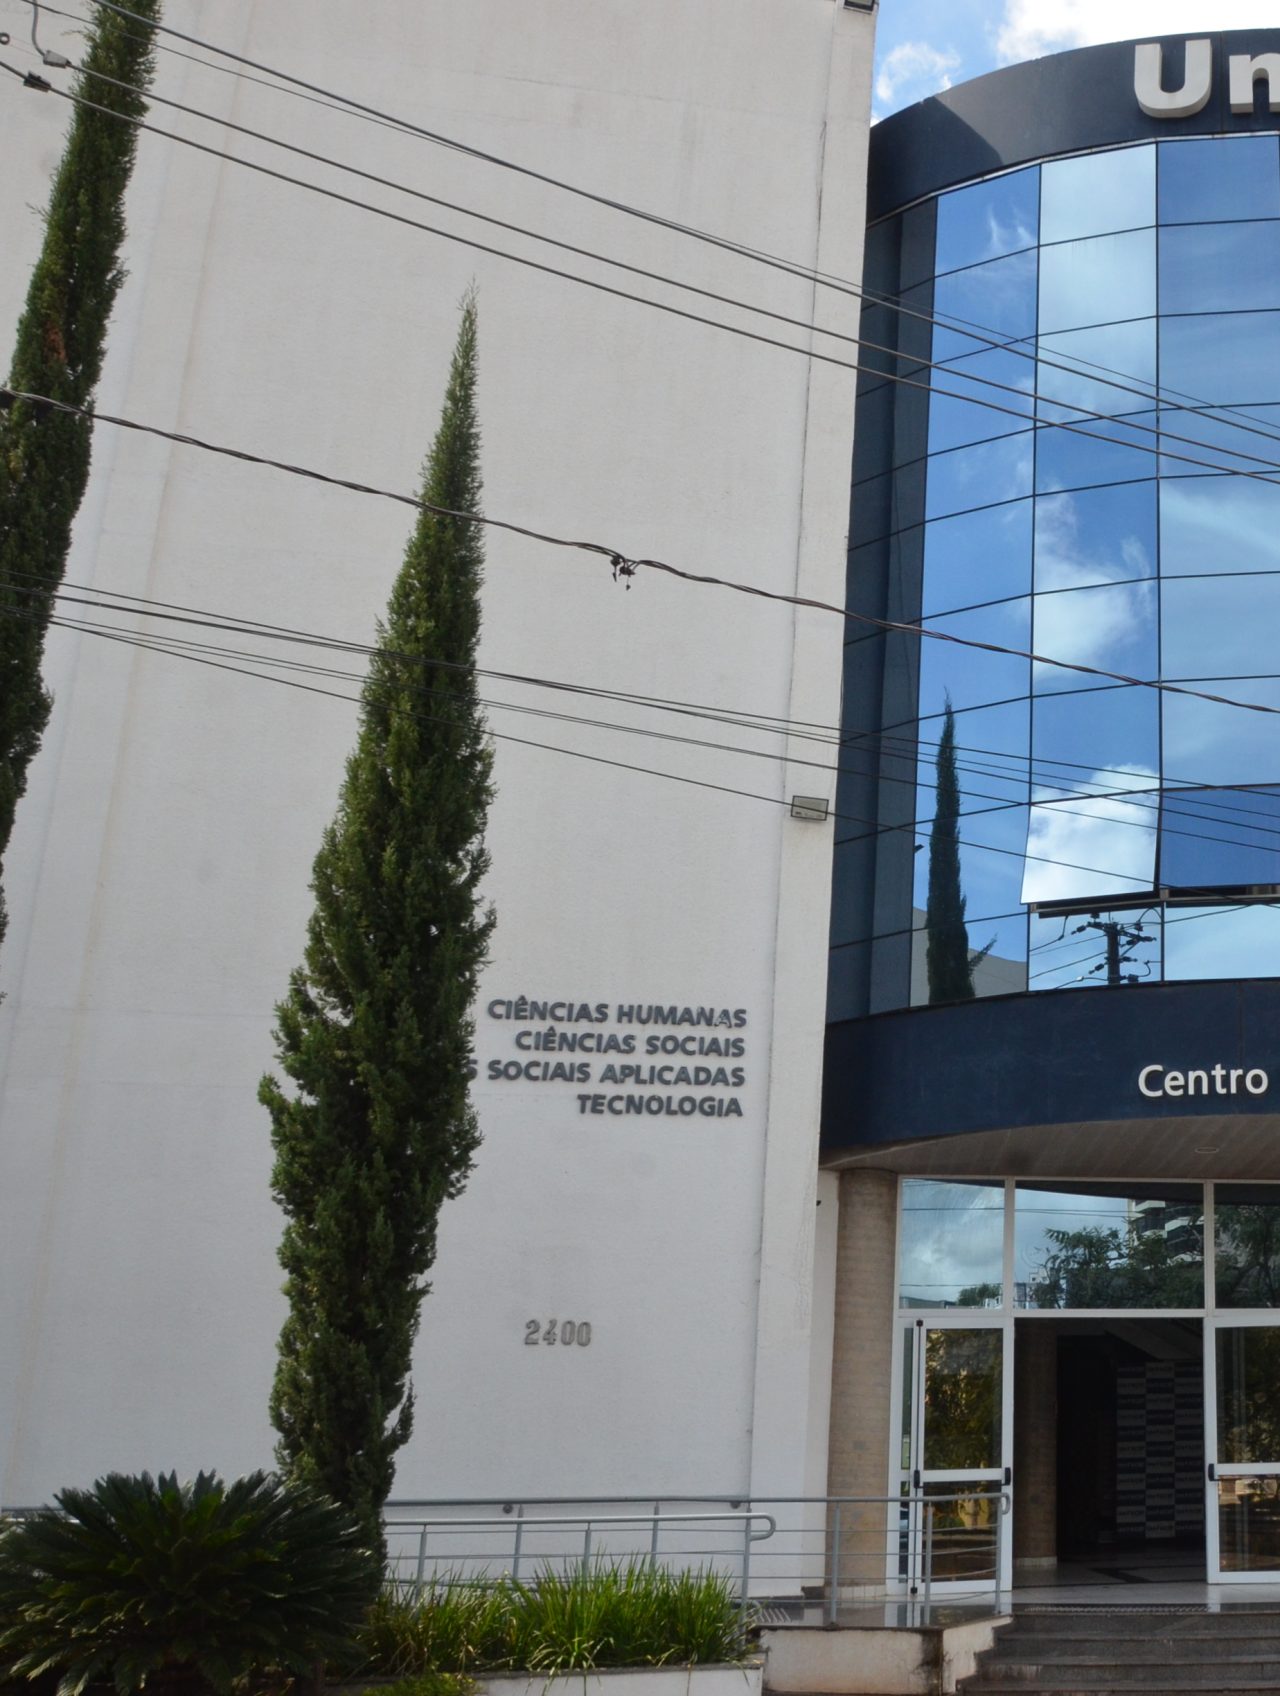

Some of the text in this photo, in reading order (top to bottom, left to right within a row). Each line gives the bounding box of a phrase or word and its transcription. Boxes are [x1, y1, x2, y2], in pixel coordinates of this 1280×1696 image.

[487, 995, 747, 1028] CIÊNCIAS HUMANAS
[515, 1026, 745, 1057] CIÊNCIAS SOCIAIS
[488, 1060, 591, 1083] SOCIAIS
[599, 1064, 745, 1087] APLICADAS
[1138, 1064, 1268, 1097] Centro
[577, 1094, 743, 1117] TECNOLOGIA
[524, 1319, 592, 1346] 2400
